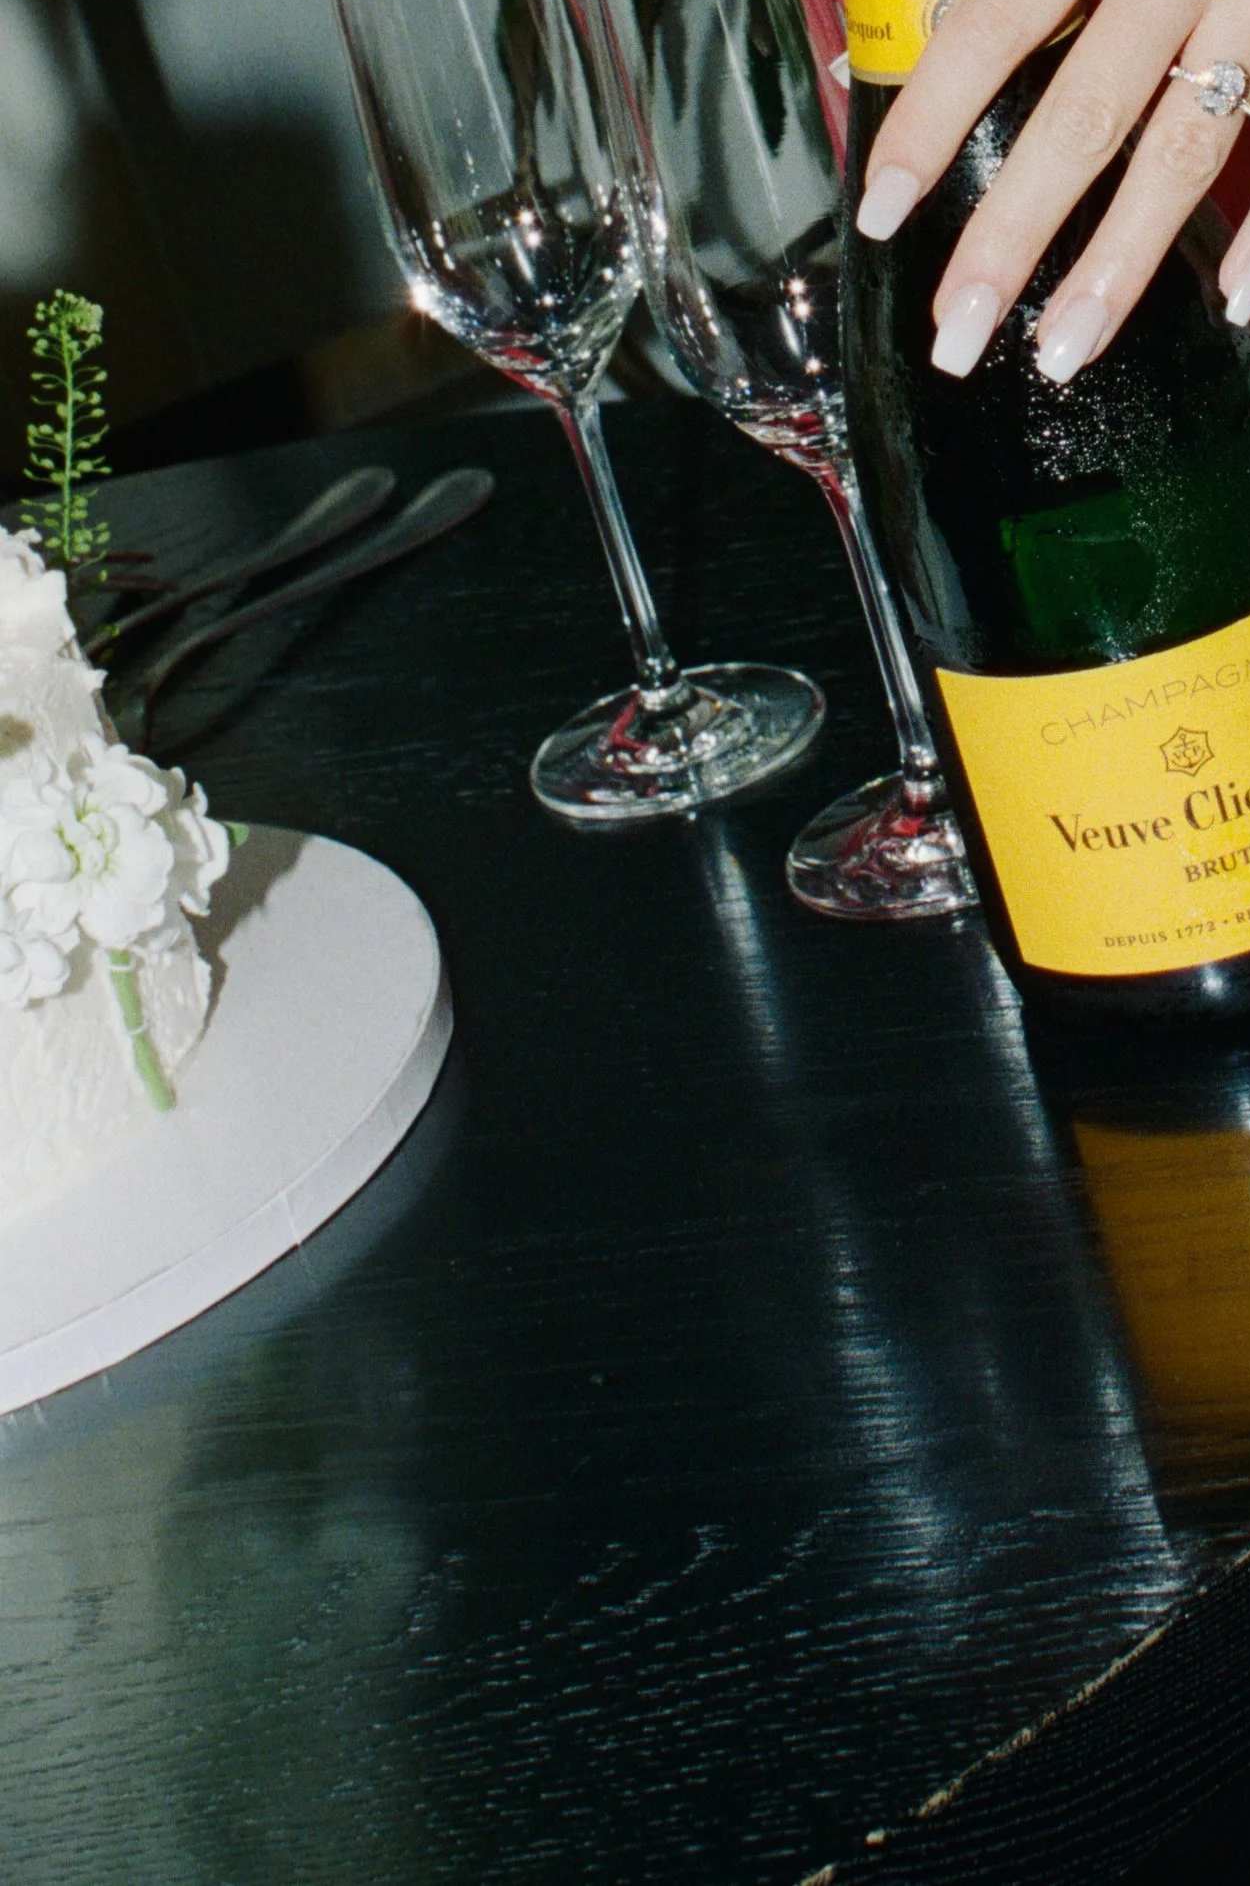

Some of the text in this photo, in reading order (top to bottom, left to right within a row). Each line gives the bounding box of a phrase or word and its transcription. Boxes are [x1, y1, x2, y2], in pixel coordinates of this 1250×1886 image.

[1046, 813, 1175, 853] Veuve
[1104, 930, 1168, 948] DEPUIS
[1175, 920, 1217, 939] 1772
